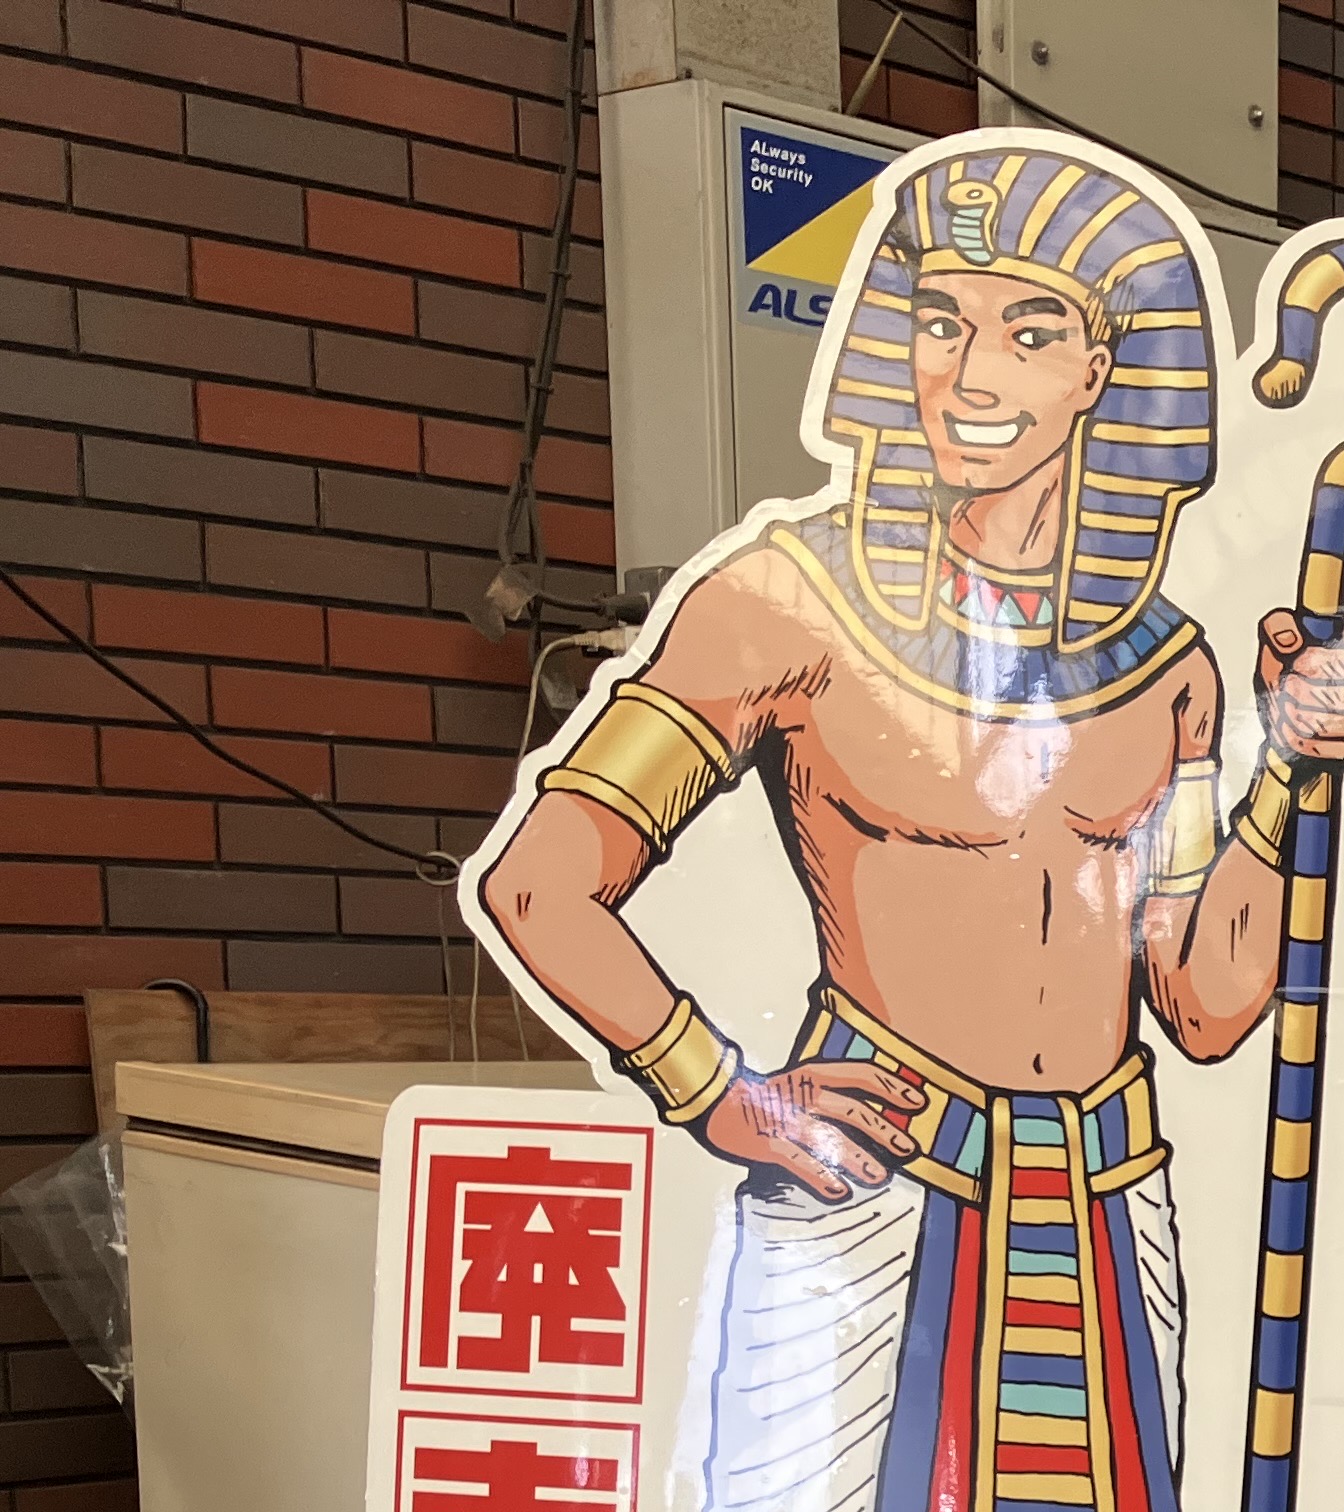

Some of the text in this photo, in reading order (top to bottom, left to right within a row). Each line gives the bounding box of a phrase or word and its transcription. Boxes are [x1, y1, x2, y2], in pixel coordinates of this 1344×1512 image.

[750, 139, 806, 165] ALways
[750, 157, 813, 187] Security
[751, 176, 774, 194] OK
